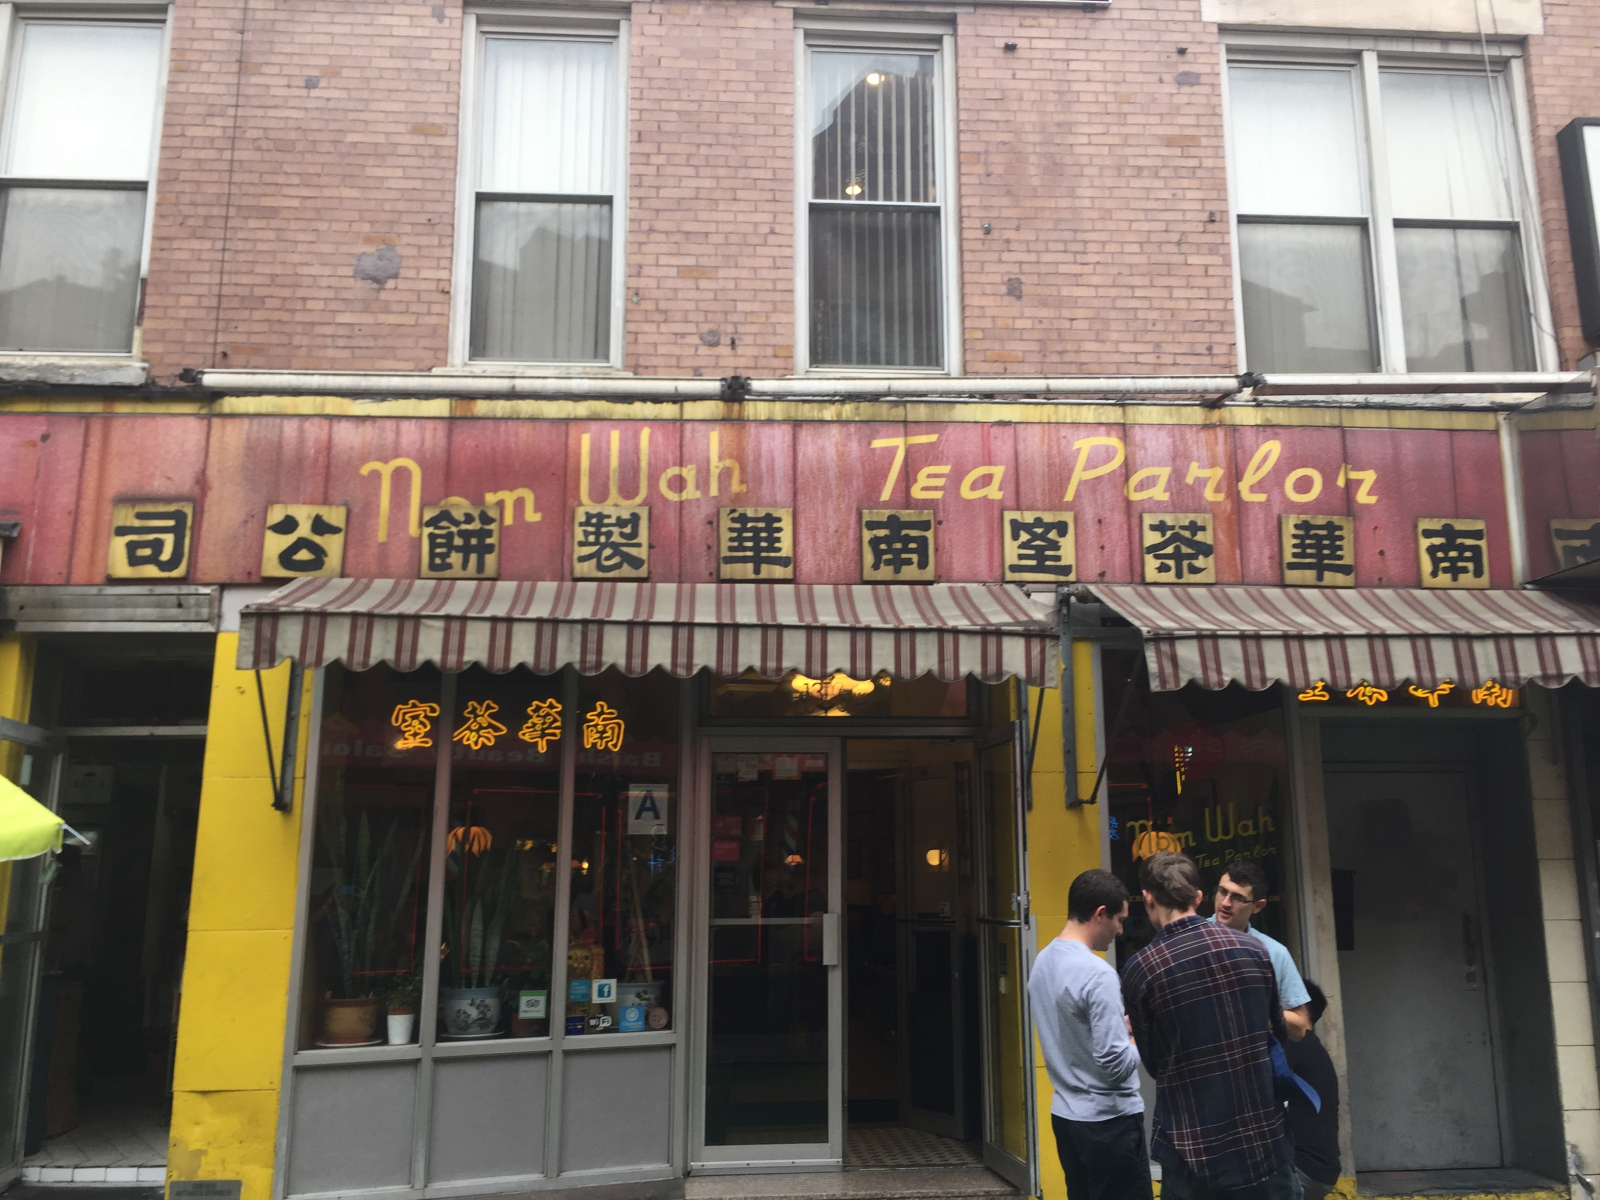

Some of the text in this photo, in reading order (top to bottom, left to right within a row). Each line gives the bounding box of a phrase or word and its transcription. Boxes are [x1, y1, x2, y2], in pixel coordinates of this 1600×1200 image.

[359, 426, 1379, 543] Nm Wah Tea Parlor
[634, 790, 661, 820] A
[1126, 819, 1196, 857] Nom
[1205, 802, 1275, 842] Wah
[1195, 846, 1277, 868] Tea Parlor
